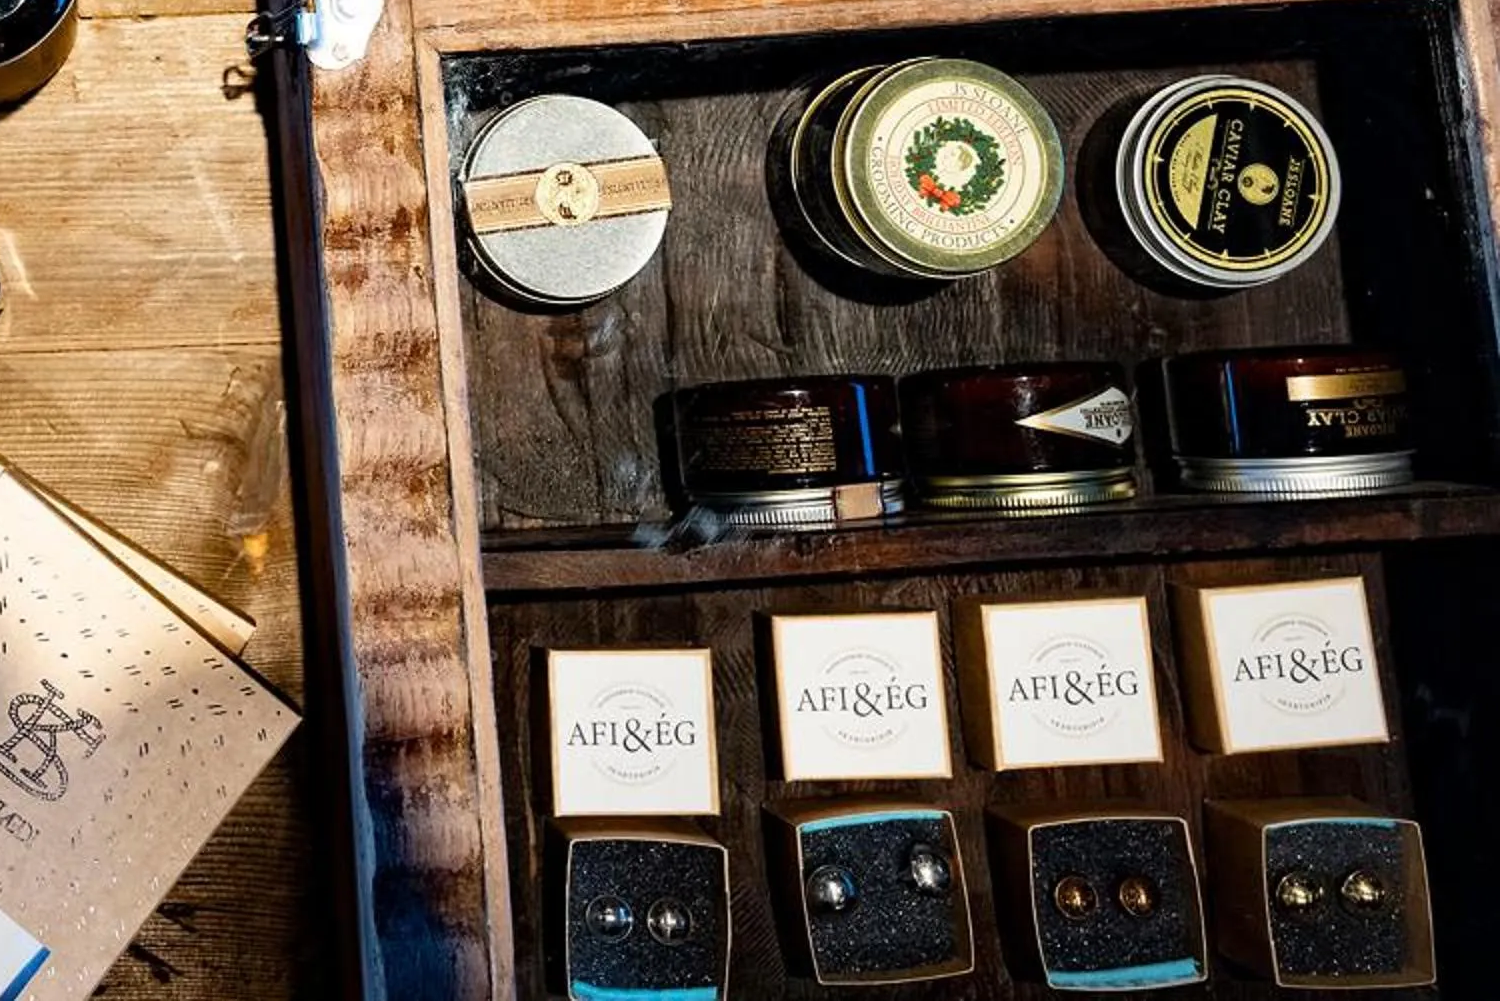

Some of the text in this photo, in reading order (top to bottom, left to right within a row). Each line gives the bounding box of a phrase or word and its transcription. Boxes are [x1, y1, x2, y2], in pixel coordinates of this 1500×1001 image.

[973, 85, 1029, 137] SLOANE
[871, 146, 1007, 249] GROOMING PRODUCTS
[1211, 118, 1244, 236] CAVIAR CLAY
[1306, 410, 1360, 427] CLAY
